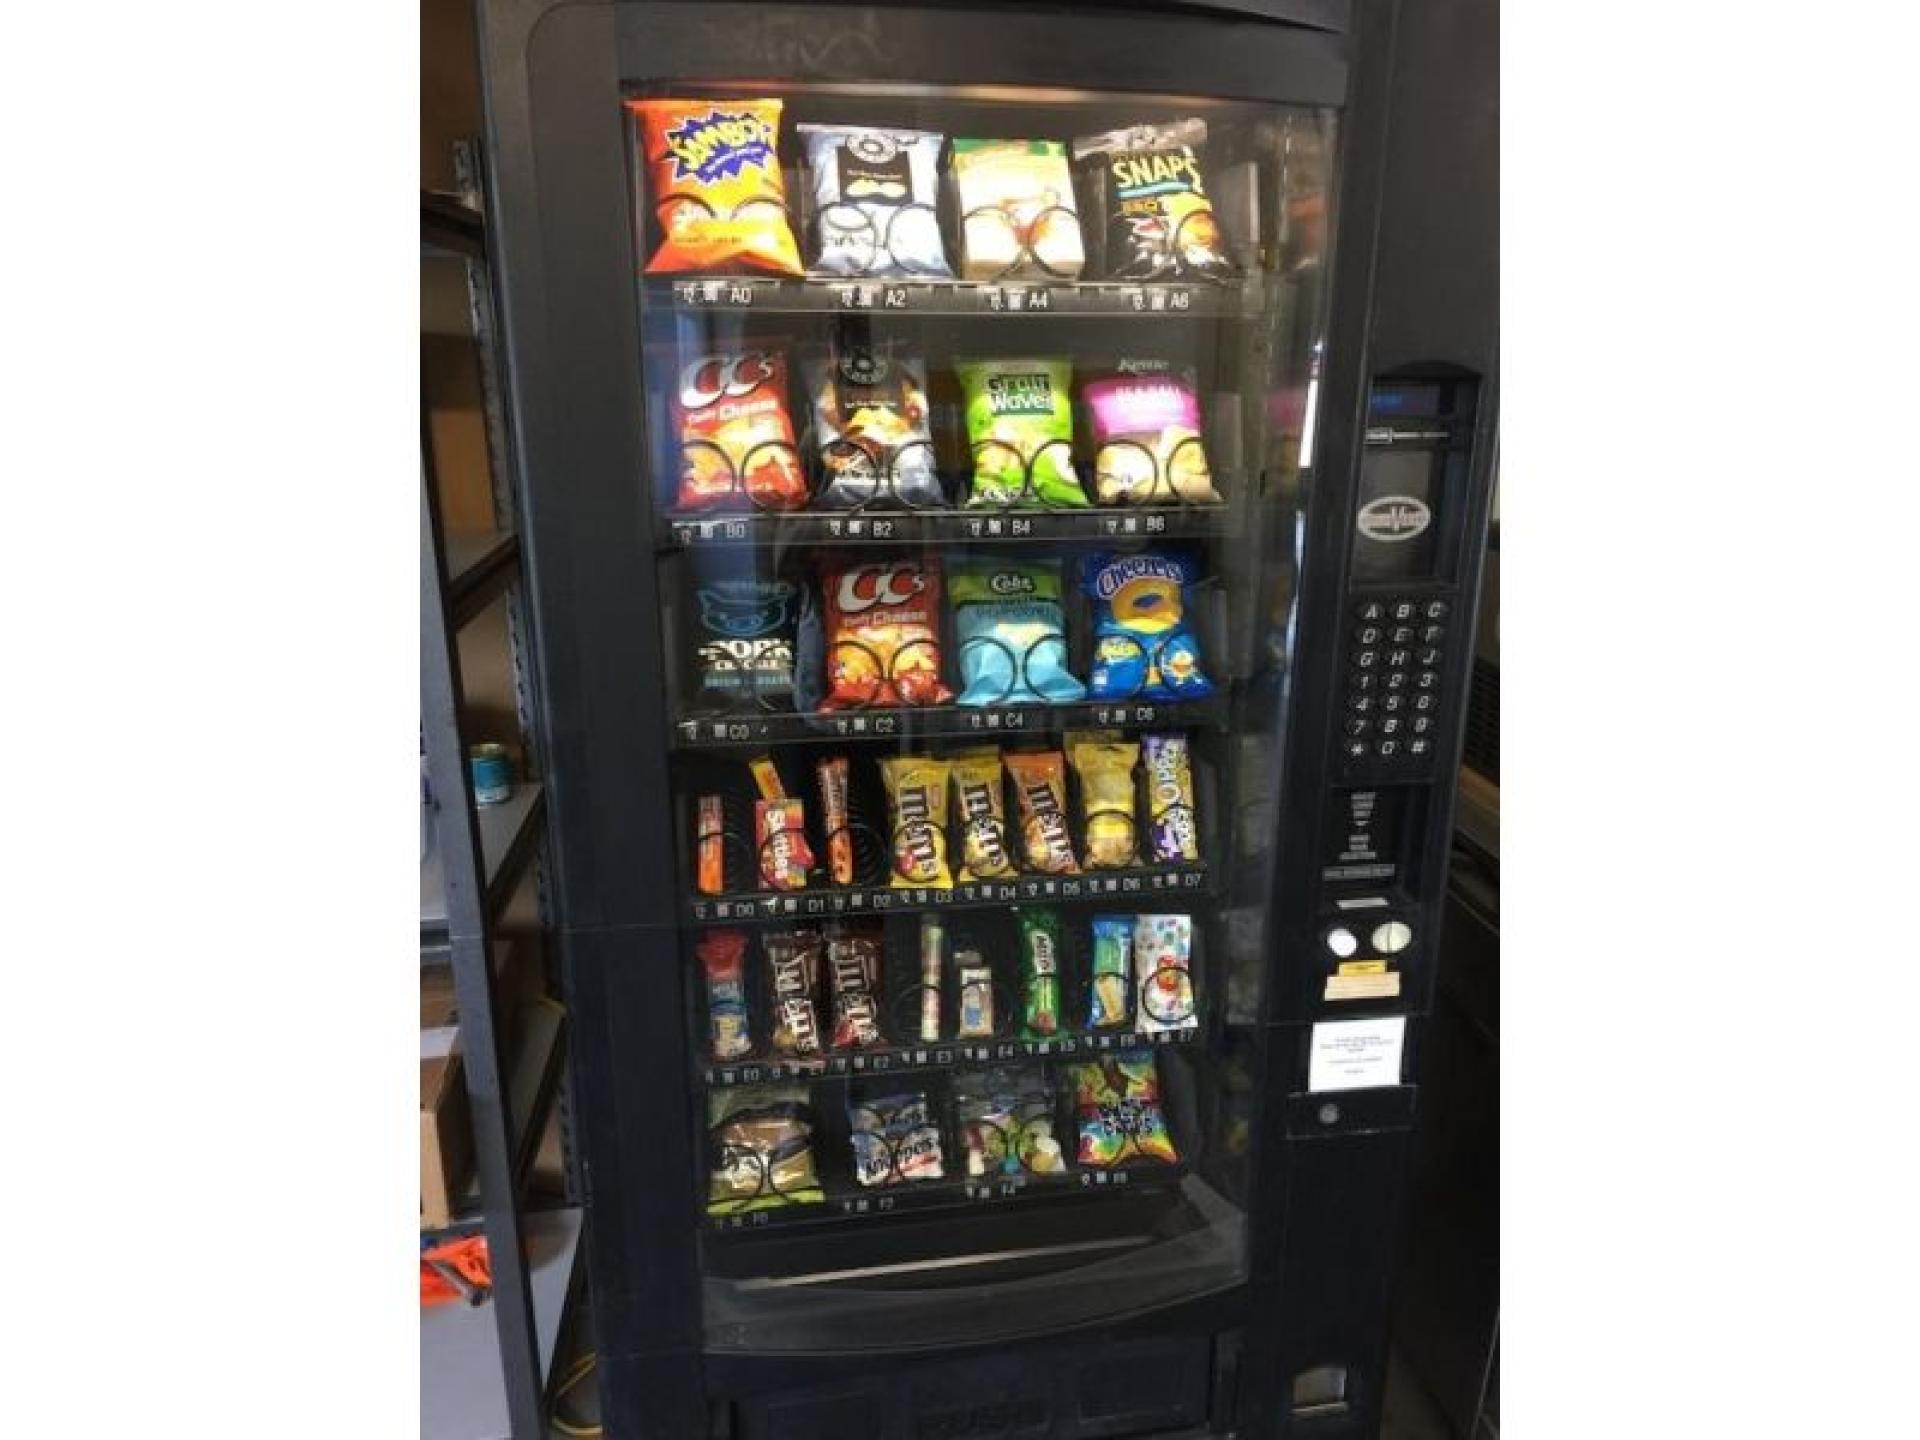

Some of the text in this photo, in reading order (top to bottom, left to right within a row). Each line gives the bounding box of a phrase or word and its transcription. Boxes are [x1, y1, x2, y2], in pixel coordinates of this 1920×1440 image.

[885, 288, 906, 306] A2
[1029, 292, 1048, 309] A4
[1365, 602, 1441, 618] A B C
[1391, 651, 1405, 665] H
[1423, 649, 1436, 665] J
[1361, 674, 1433, 689] 1 2 3
[1356, 698, 1368, 711] 4
[1354, 719, 1366, 734] 7
[1384, 719, 1397, 732] 8
